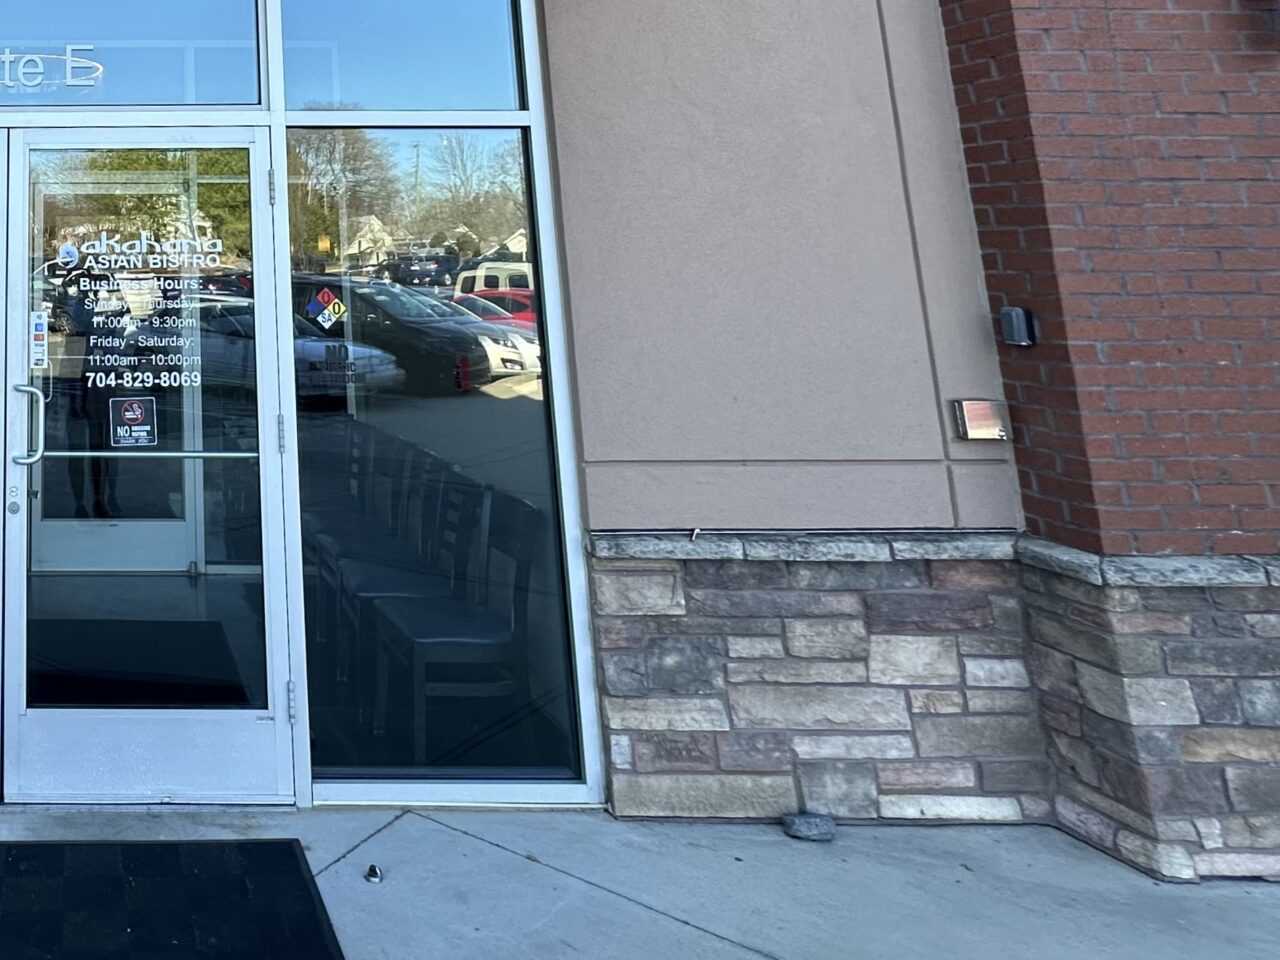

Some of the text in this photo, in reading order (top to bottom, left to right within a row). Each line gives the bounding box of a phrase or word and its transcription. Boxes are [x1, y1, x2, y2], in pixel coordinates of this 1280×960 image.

[65, 44, 96, 87] E
[83, 254, 221, 269] ASIAN BISTRO
[79, 277, 204, 291] Business Hours:
[332, 301, 341, 315] 0
[92, 316, 141, 328] 11:00am
[152, 316, 197, 329] 9:30pm
[89, 335, 127, 348] Friday
[137, 335, 195, 348] Saturday:
[87, 354, 139, 366] 11:00am
[151, 354, 202, 368] 10:00pm
[85, 372, 202, 388] 704-829-8069
[116, 425, 130, 437] NO
